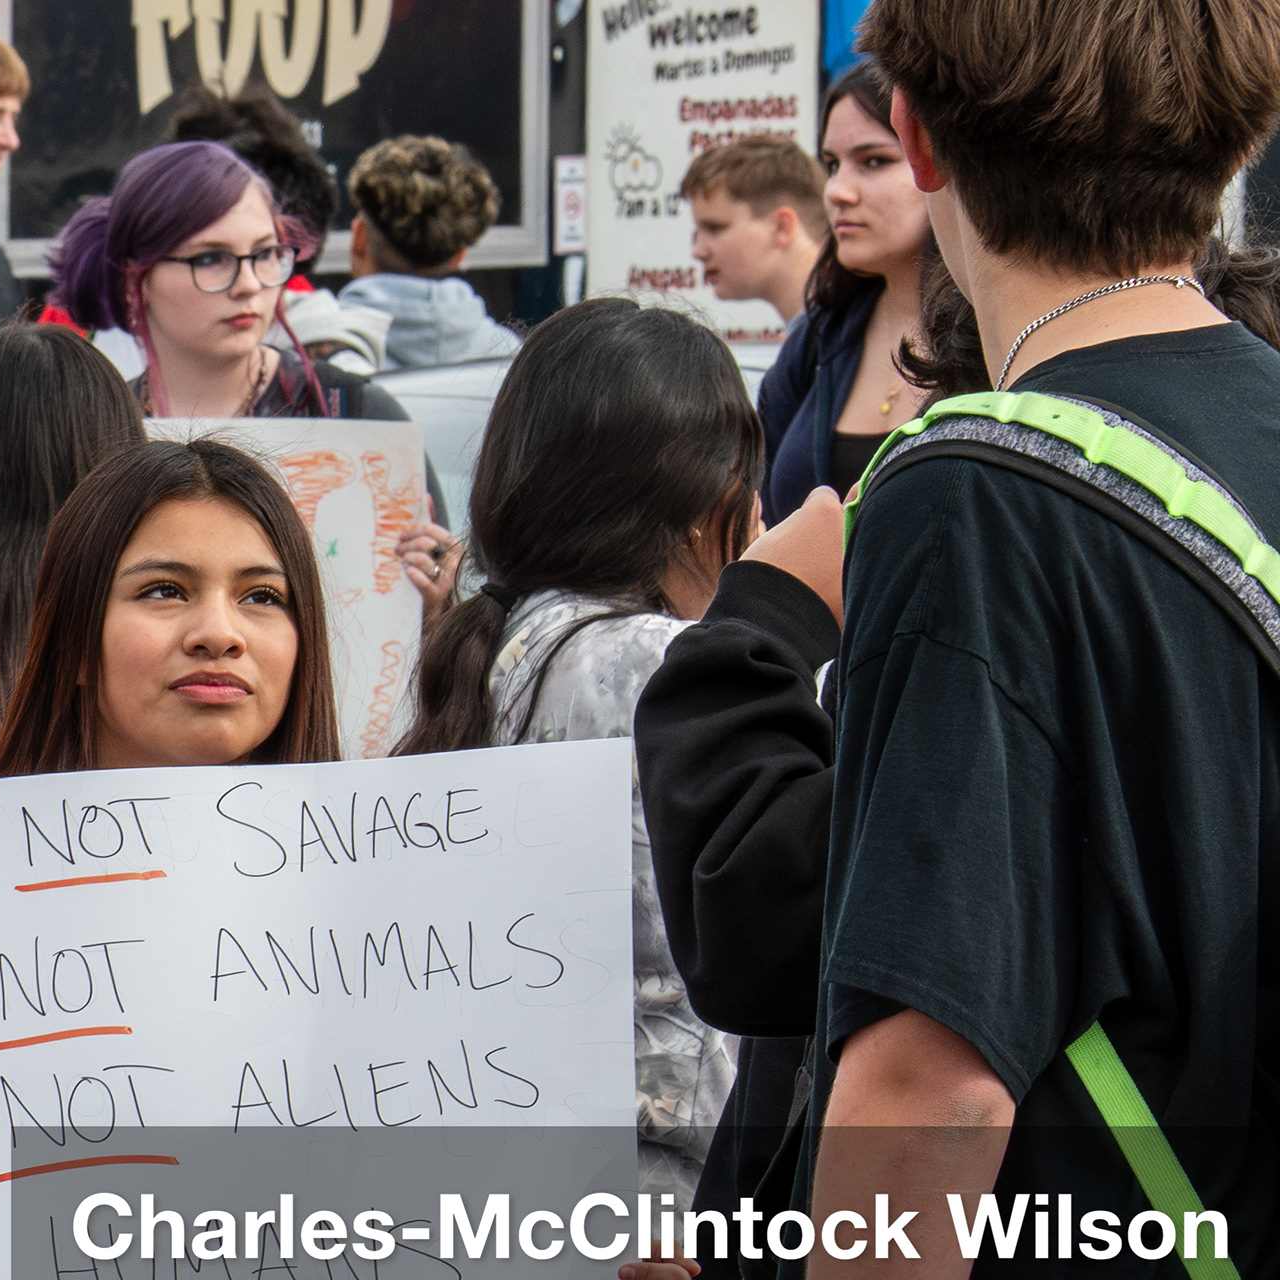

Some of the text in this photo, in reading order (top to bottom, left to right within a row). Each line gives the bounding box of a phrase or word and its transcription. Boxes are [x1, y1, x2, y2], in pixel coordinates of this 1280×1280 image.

[679, 96, 799, 124] Empanadas
[628, 265, 696, 292] Arepas
[21, 796, 171, 867] NOT
[217, 782, 488, 877] SAVAGE
[210, 913, 564, 1001] ANIMALS
[0, 1063, 175, 1149] NOT
[232, 1039, 540, 1132] ALIENS
